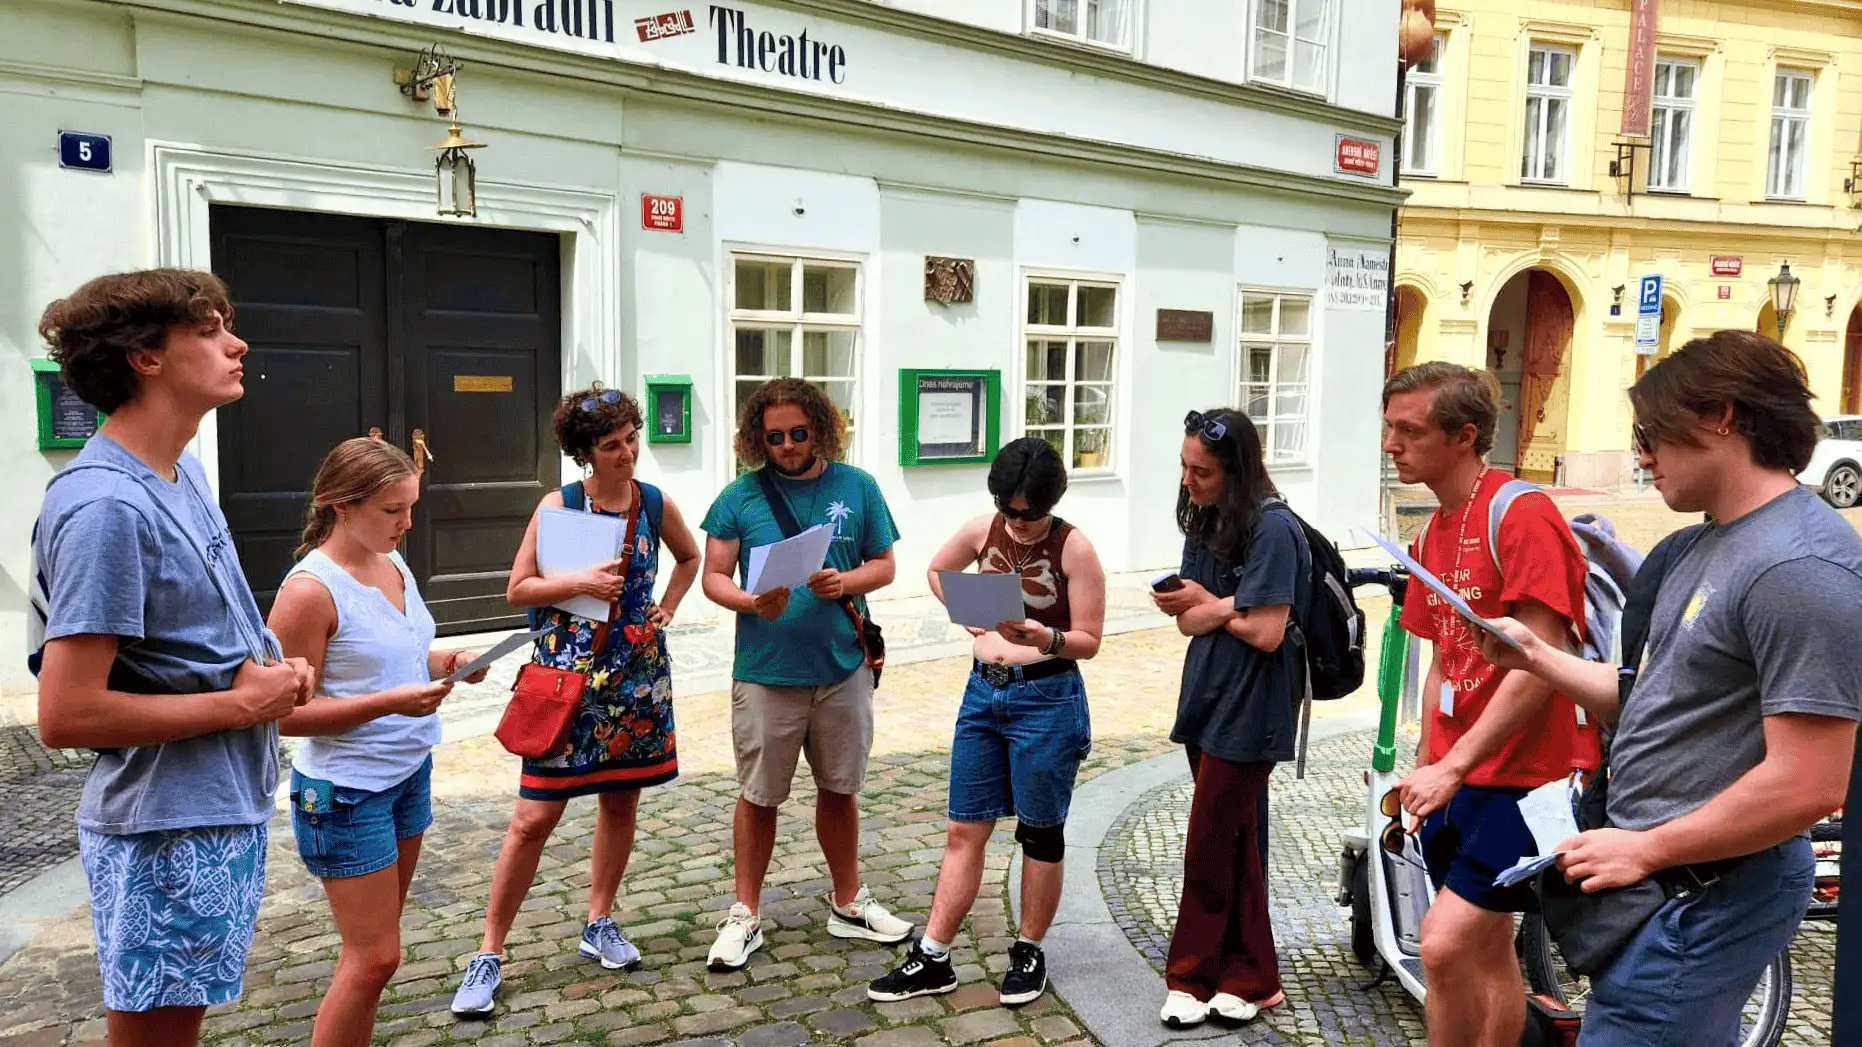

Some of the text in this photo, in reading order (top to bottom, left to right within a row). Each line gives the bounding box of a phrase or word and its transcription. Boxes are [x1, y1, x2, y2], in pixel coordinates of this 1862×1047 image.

[709, 5, 846, 84] Theatre
[1633, 0, 1648, 91] PALACE
[79, 141, 92, 162] 5
[651, 199, 675, 215] 209
